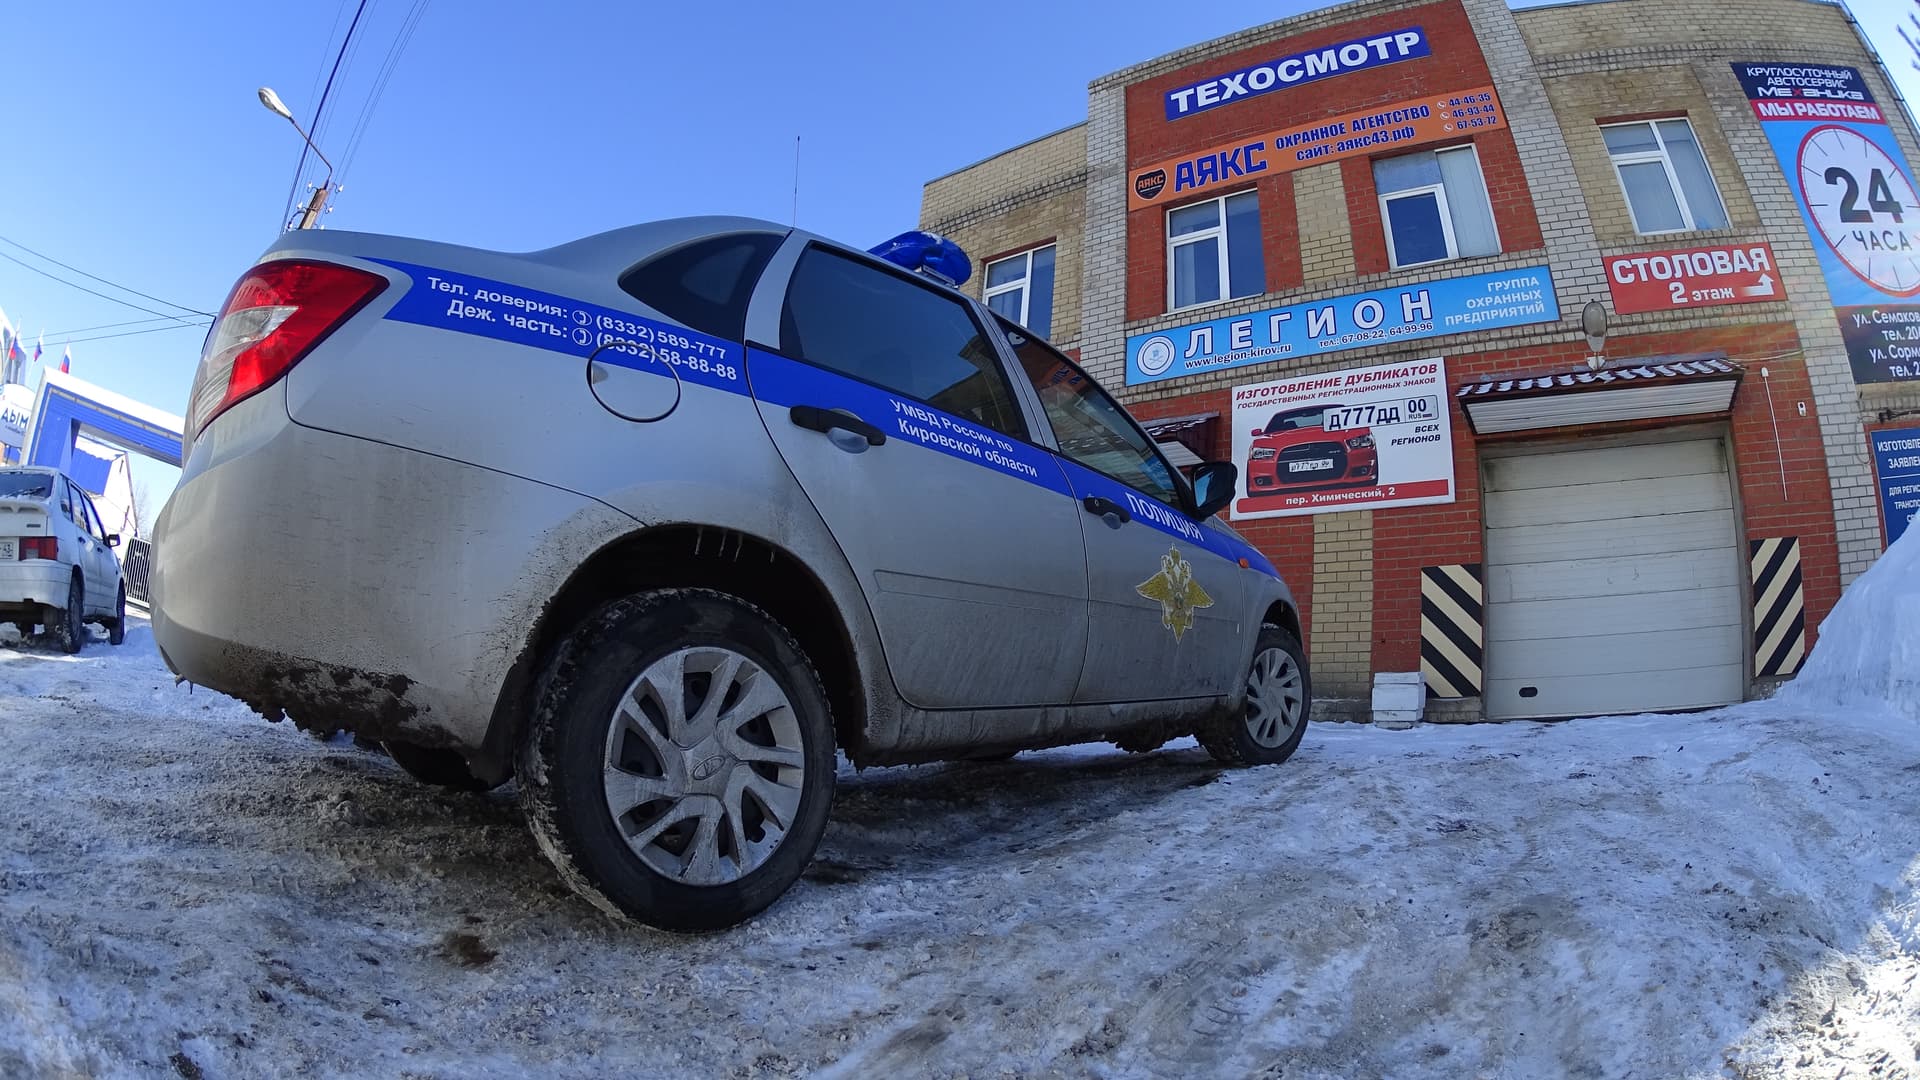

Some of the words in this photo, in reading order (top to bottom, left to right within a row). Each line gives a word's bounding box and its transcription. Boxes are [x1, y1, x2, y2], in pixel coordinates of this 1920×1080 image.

[1170, 30, 1420, 113] ТЕХОСМОТР
[1746, 66, 1852, 81] КРУГЛОСУТОЧНЫЙ
[1449, 93, 1491, 107] 44-46-35
[1452, 104, 1495, 119] 46-93-44
[1757, 102, 1795, 117] МЫ
[1794, 102, 1880, 121] РАБОТАЕМ
[1275, 123, 1346, 150] ОХРАННОЕ
[1352, 105, 1430, 132] АГЕНТСТВО
[1457, 116, 1497, 130] 67-53-72
[1296, 143, 1336, 161] сайт:
[1337, 126, 1416, 153] аякс43.рф
[1174, 142, 1268, 193] АЯКС
[1824, 166, 1904, 223] 24
[1852, 230, 1913, 251] ЧАСА
[1612, 247, 1771, 284] СТОЛОВАЯ
[1487, 276, 1540, 293] ГРУППА
[1668, 281, 1688, 304] 2
[1691, 287, 1735, 301] этаж
[1466, 289, 1543, 309] ОХРАННЫХ
[427, 275, 470, 297] Тел.
[473, 288, 568, 319] доверия:
[596, 314, 655, 343] (8332)
[657, 330, 727, 361] 589-777
[1184, 289, 1433, 358] ЛЕГИОН
[1445, 301, 1545, 326] ПРЕДПРИЯТИЙ
[1852, 313, 1872, 329] ул.
[446, 298, 496, 323] Деж.
[503, 312, 568, 339] часть:
[660, 348, 737, 381] 58-88-88
[1389, 322, 1433, 336] 64-99-96
[1881, 329, 1905, 341] тел.
[1185, 343, 1292, 370] www.legion-kirov.ru
[1869, 348, 1888, 364] ул.
[1889, 365, 1913, 377] тел.
[1236, 376, 1342, 401] ИЗГОТОВЛЕНИЕ
[1344, 363, 1438, 388] ДУБЛИКАТОВ
[1237, 392, 1316, 410] ГОСУДАРСТВЕННЫХ
[1318, 382, 1401, 400] РЕГИСТРАЦИОННЫХ
[1403, 376, 1436, 389] ЗНАКОВ
[1407, 398, 1427, 413] 00
[1408, 412, 1422, 420] RUS
[890, 398, 941, 430] УМВД
[943, 416, 993, 447] России
[996, 435, 1013, 453] по
[1414, 424, 1440, 434] ВСЕХ
[898, 417, 982, 459] Кировской
[984, 448, 1038, 478] области
[1391, 433, 1441, 447] РЕГИОНОВ
[1285, 496, 1308, 506] пер.
[1311, 488, 1385, 503] Химический,
[1388, 486, 1395, 496] 2
[1125, 491, 1205, 542] ПОЛИЦИЯ
